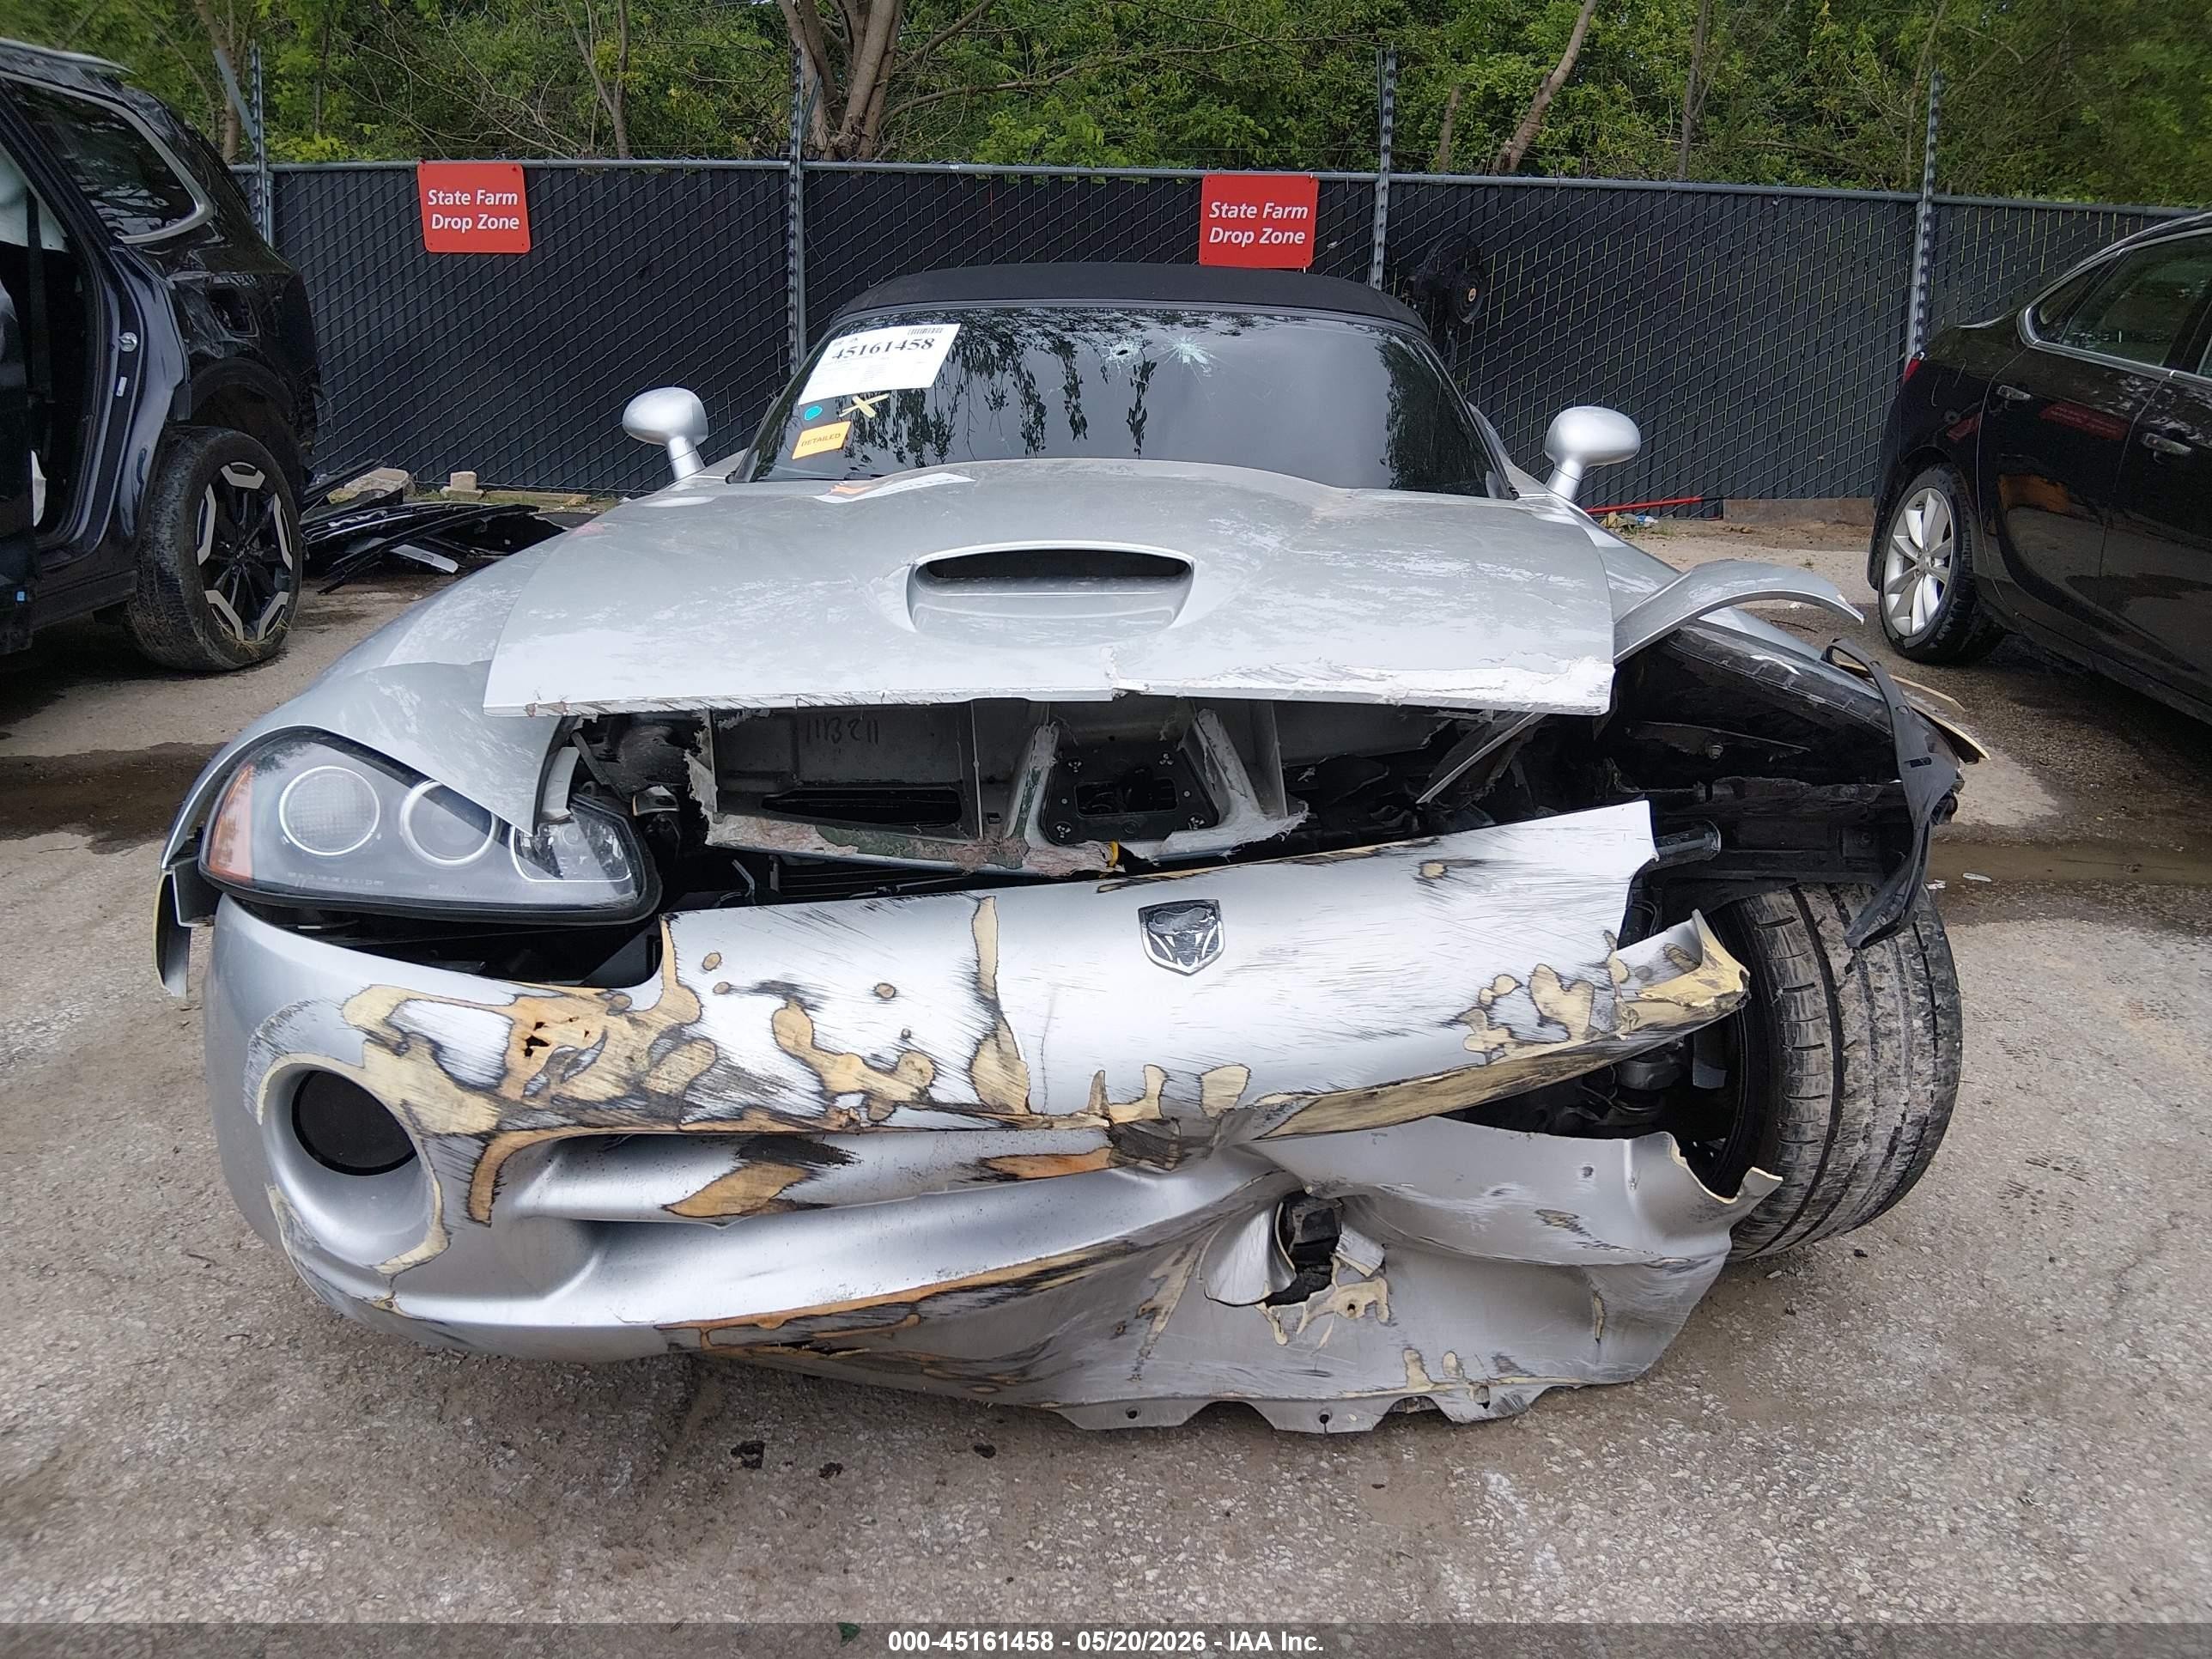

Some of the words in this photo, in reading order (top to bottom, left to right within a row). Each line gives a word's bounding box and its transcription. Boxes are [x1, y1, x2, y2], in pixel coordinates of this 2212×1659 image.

[428, 189, 471, 205] State
[476, 190, 518, 205] Farm
[1209, 202, 1257, 219] State
[1262, 203, 1308, 219] Farm
[431, 214, 472, 233] Drop
[477, 214, 520, 229] Zone
[1209, 228, 1255, 247] Drop
[1259, 228, 1305, 244] Zone
[832, 337, 935, 361] 45161458
[800, 432, 842, 447] DETAILED
